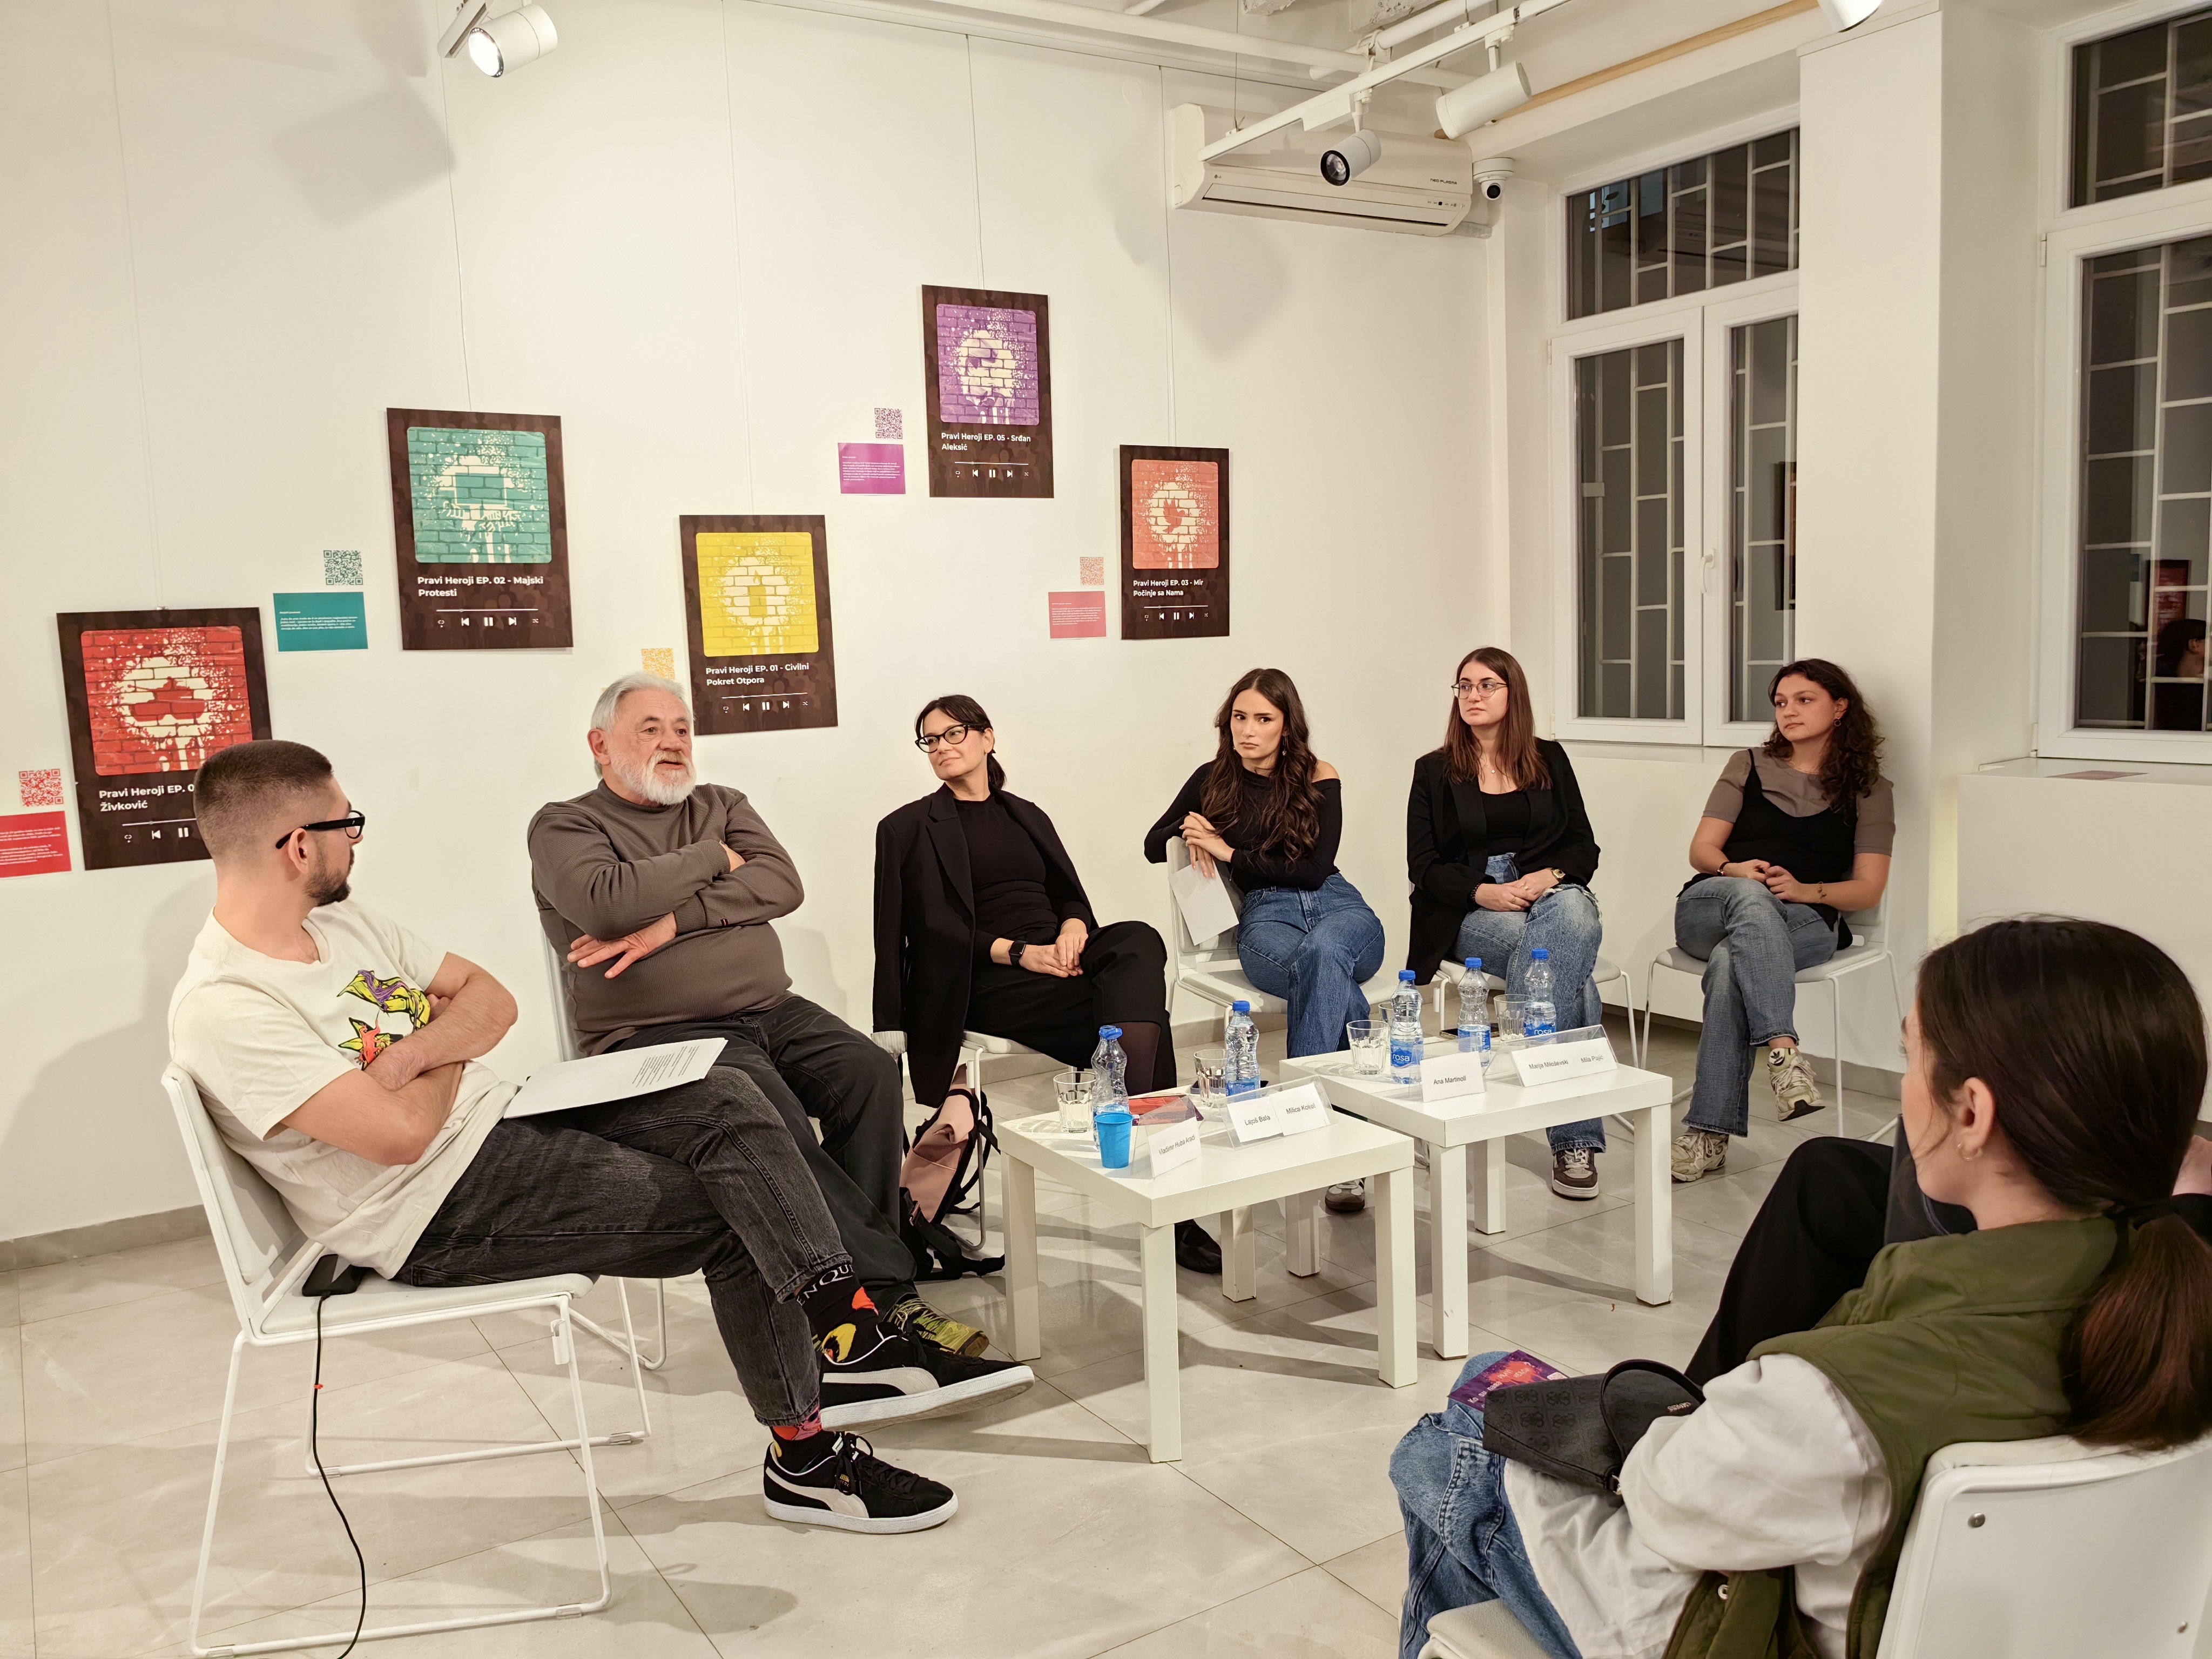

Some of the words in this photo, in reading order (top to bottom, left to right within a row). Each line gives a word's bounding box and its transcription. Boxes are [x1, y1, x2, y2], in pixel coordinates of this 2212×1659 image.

[961, 433, 983, 442] Heroji
[417, 576, 443, 584] Pravi
[445, 576, 474, 586] Heroji
[514, 576, 544, 586] Majski
[1150, 579, 1169, 588] Heroji
[419, 589, 457, 597] Protesti
[1134, 589, 1156, 597] Počinje
[706, 666, 727, 675] Pravi
[729, 665, 753, 674] Heroji
[785, 663, 810, 671] Civilni
[706, 678, 734, 686] Pokret
[736, 677, 764, 685] Otpora
[99, 788, 129, 799] Pravi
[131, 785, 165, 797] Heroji
[167, 785, 185, 793] EP.
[100, 800, 149, 812] Živković
[1392, 1054, 1410, 1062] rosa
[1445, 1075, 1467, 1083] Martinoli
